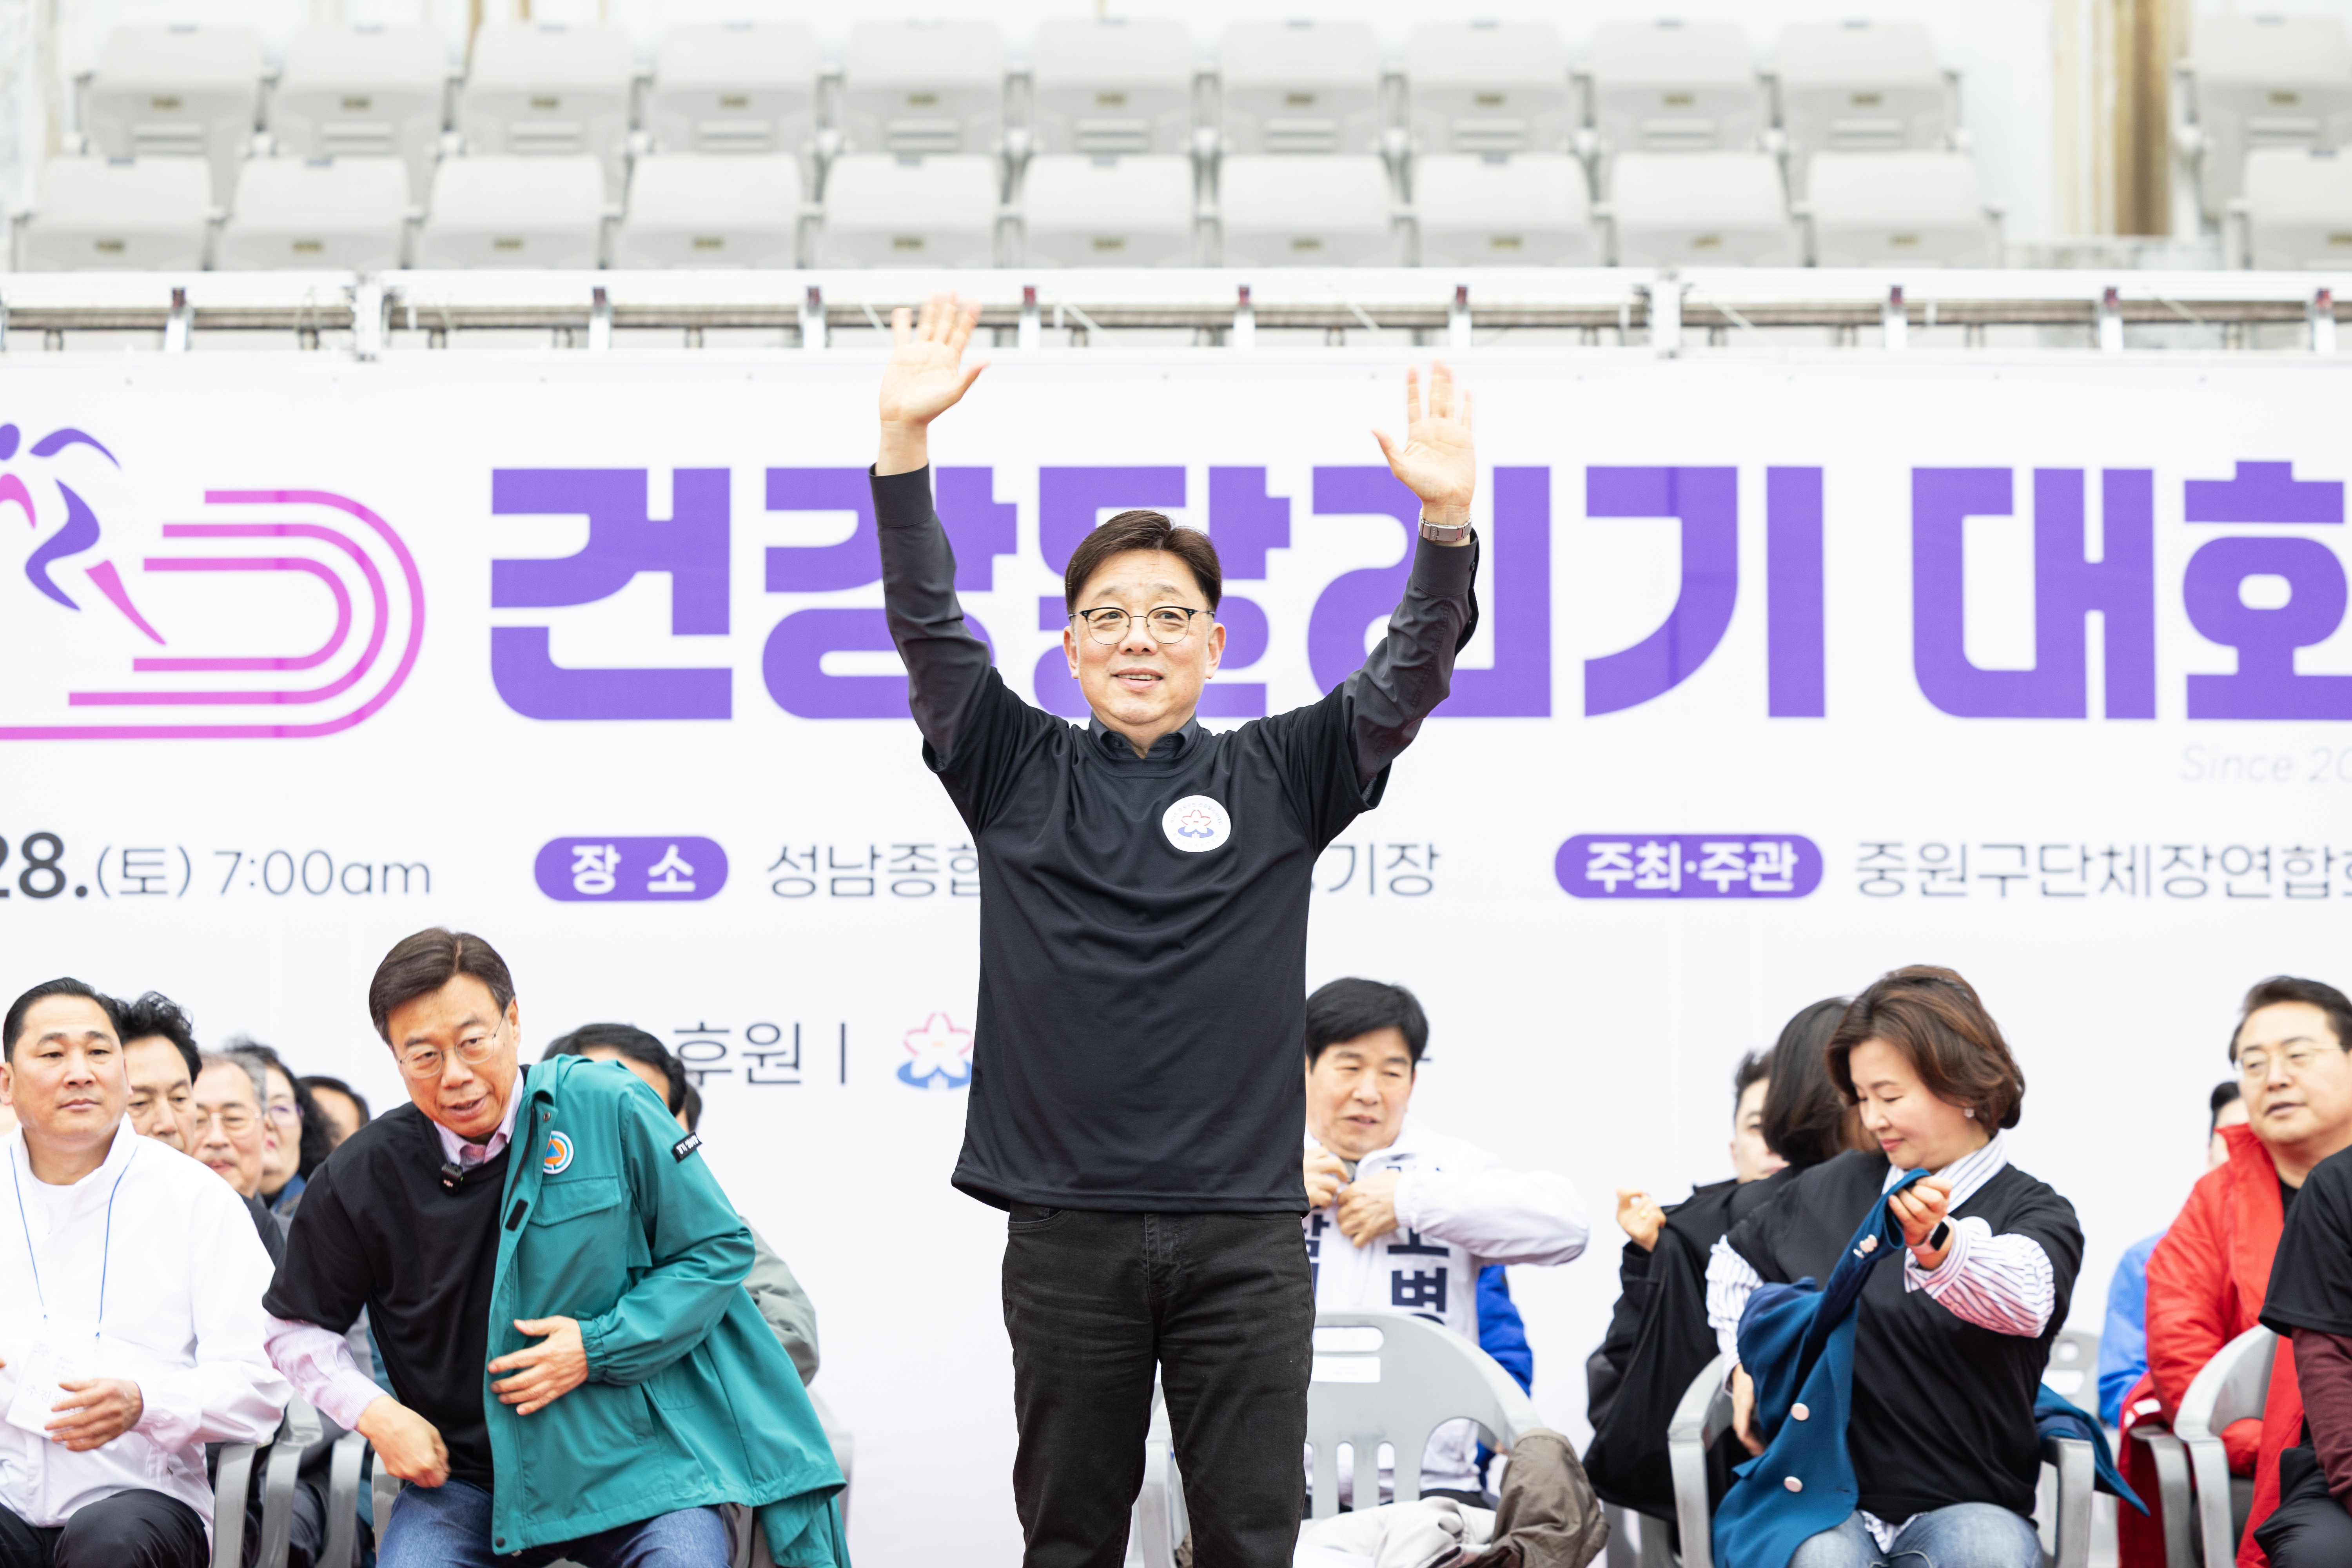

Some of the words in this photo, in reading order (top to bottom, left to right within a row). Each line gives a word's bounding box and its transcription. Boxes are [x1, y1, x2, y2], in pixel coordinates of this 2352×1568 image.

[2179, 744, 2294, 783] Since
[213, 849, 431, 897] 7:00am
[1585, 840, 1800, 893] 주최·주관
[1855, 842, 2352, 899] 중원구단체장연합
[673, 1020, 803, 1086] 후원
